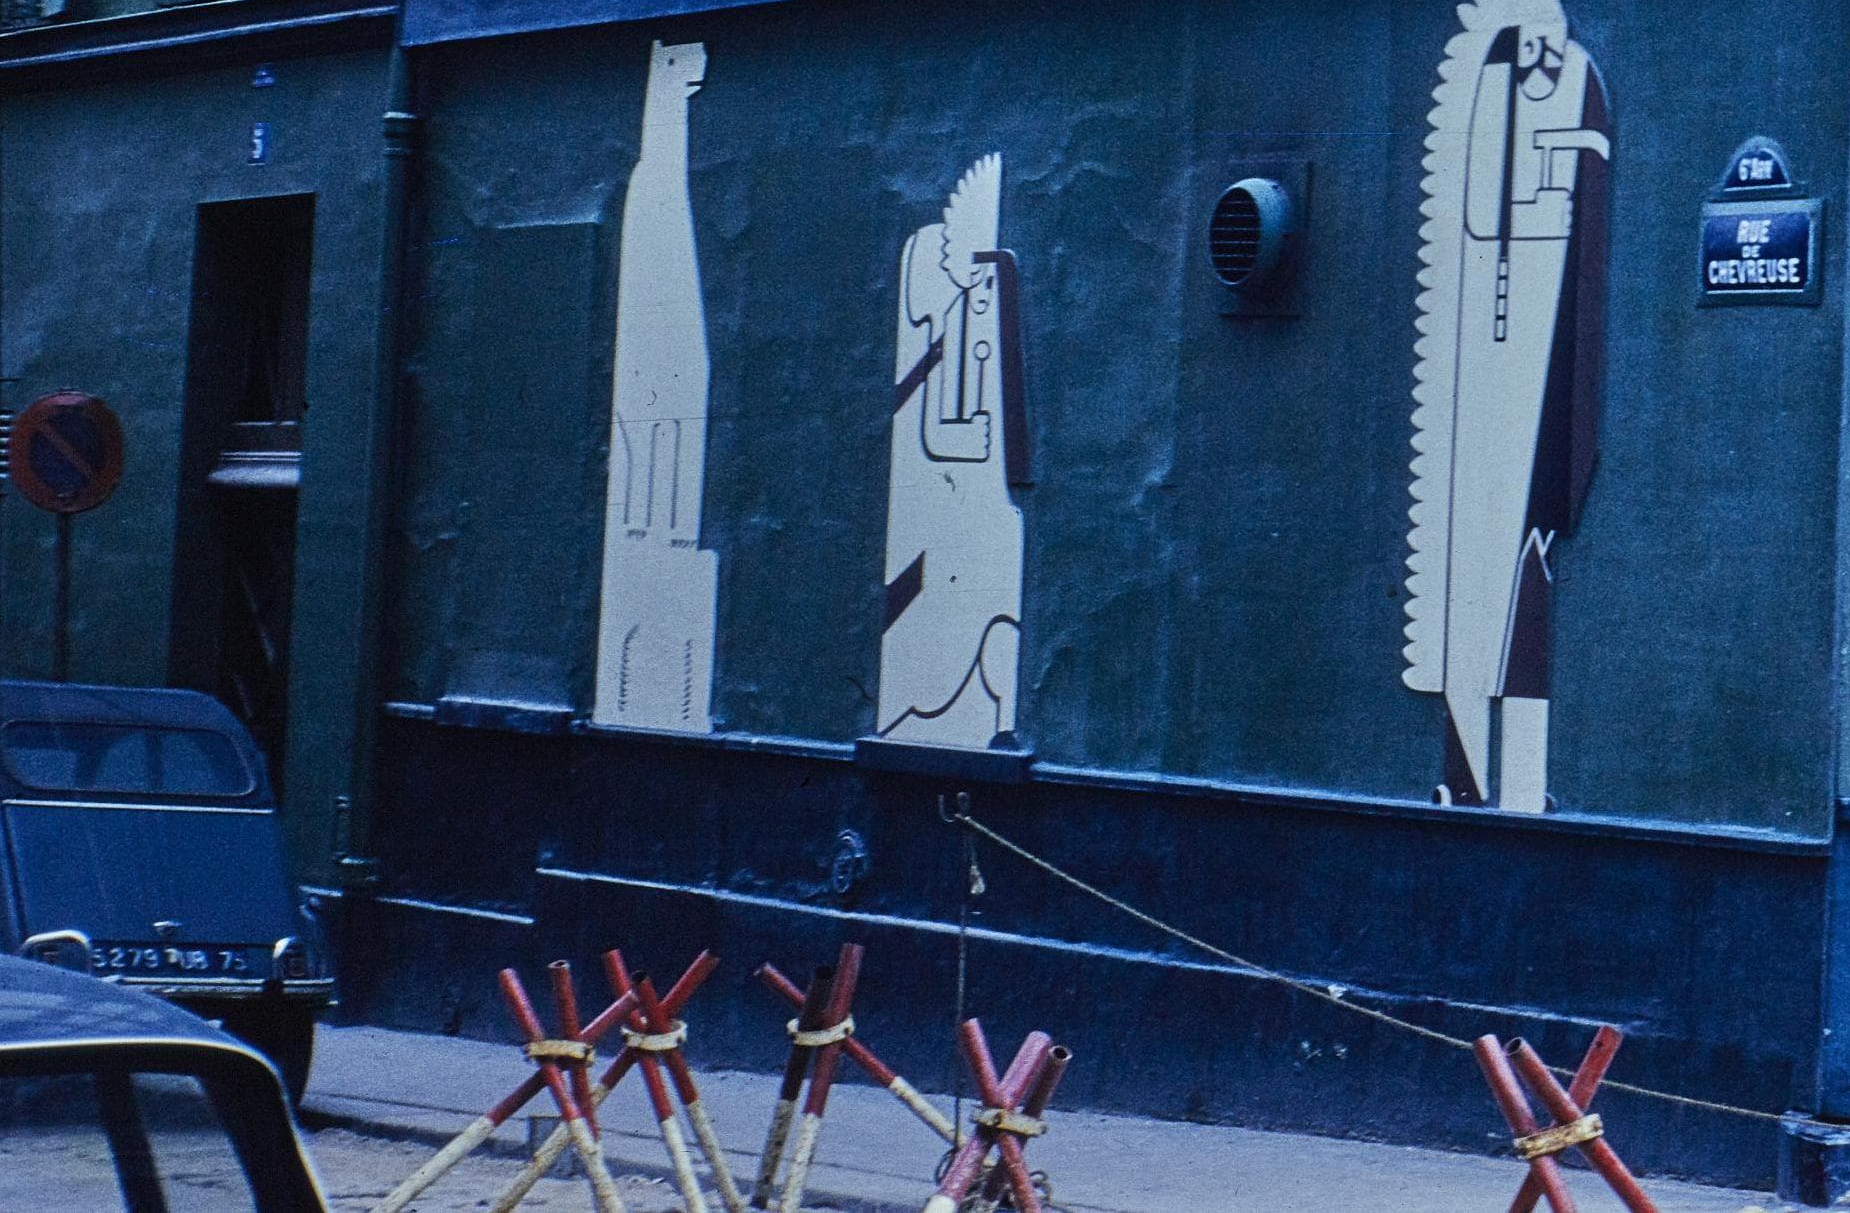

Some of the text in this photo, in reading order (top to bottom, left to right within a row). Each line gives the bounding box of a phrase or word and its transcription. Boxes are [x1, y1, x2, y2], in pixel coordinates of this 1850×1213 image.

[1736, 219, 1772, 244] RUE
[1741, 245, 1761, 258] DE
[1708, 258, 1801, 284] CHEVREUSE
